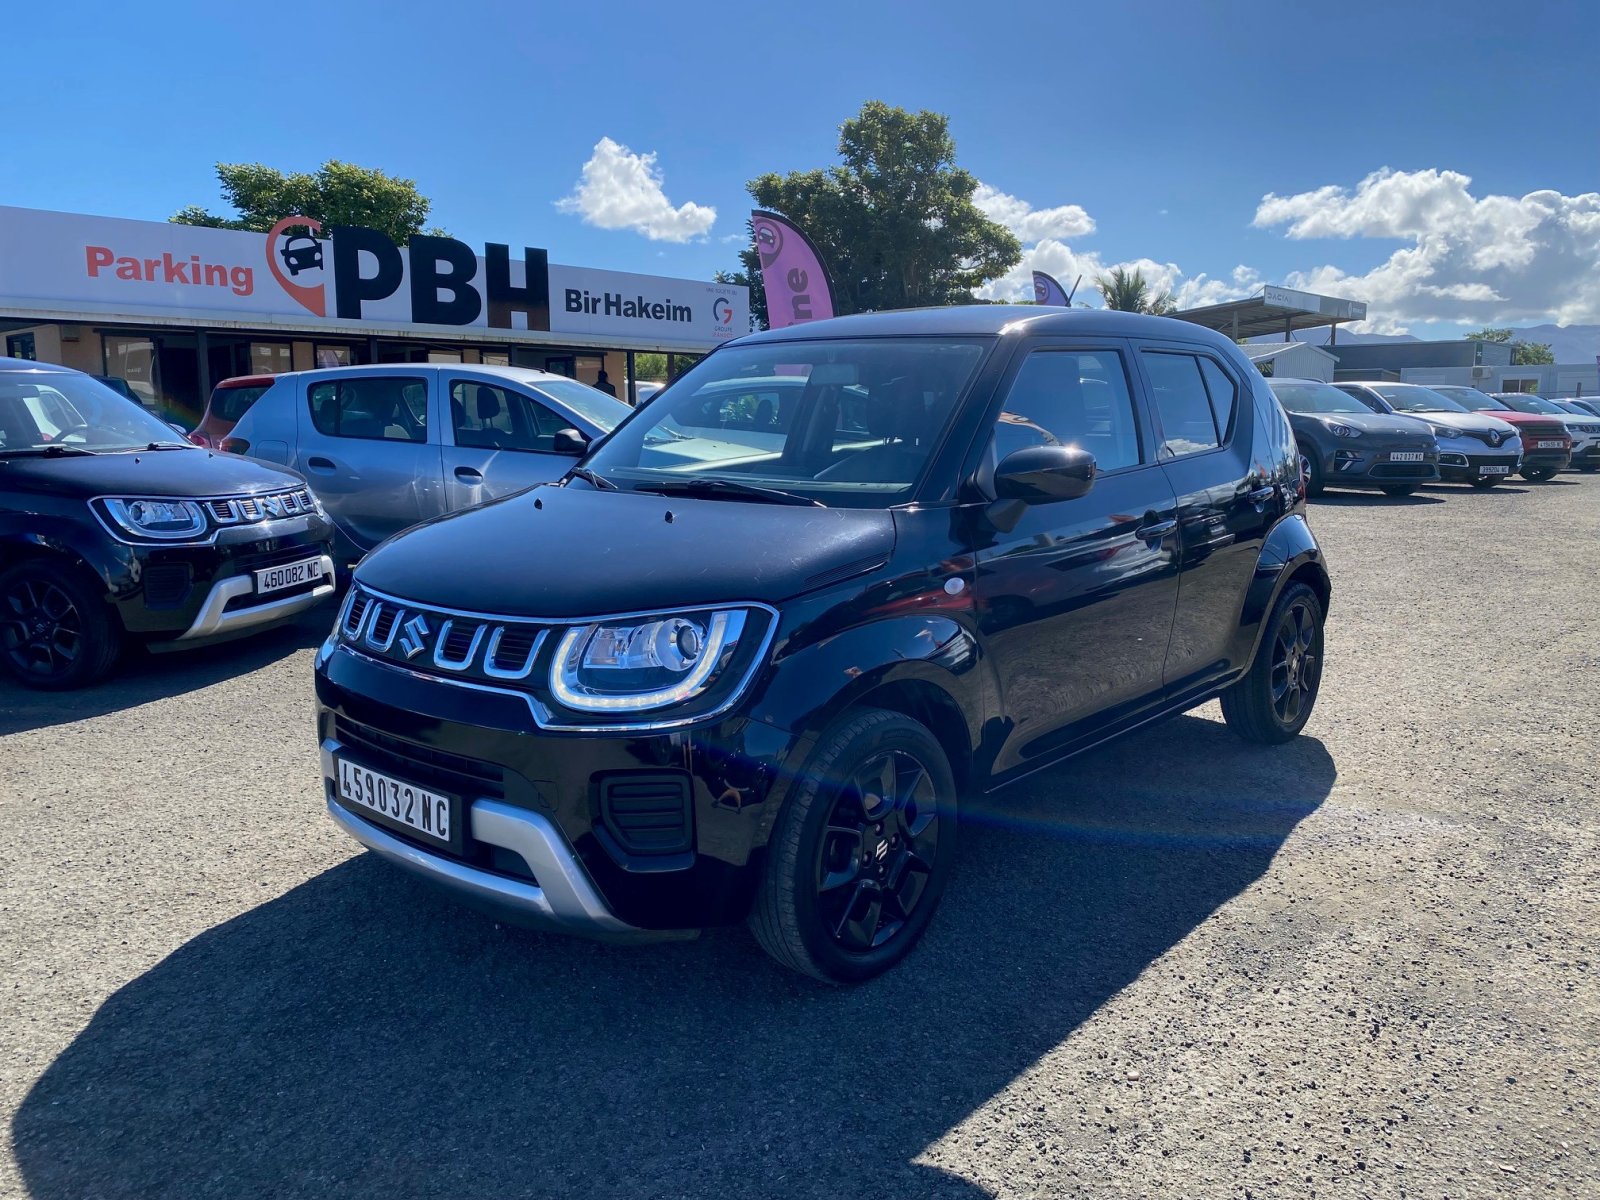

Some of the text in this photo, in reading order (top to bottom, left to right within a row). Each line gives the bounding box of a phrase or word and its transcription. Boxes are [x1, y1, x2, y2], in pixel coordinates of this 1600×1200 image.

[85, 246, 254, 297] Parking
[332, 225, 550, 332] PBH
[787, 267, 813, 325] ne
[264, 561, 319, 589] 460082 NC
